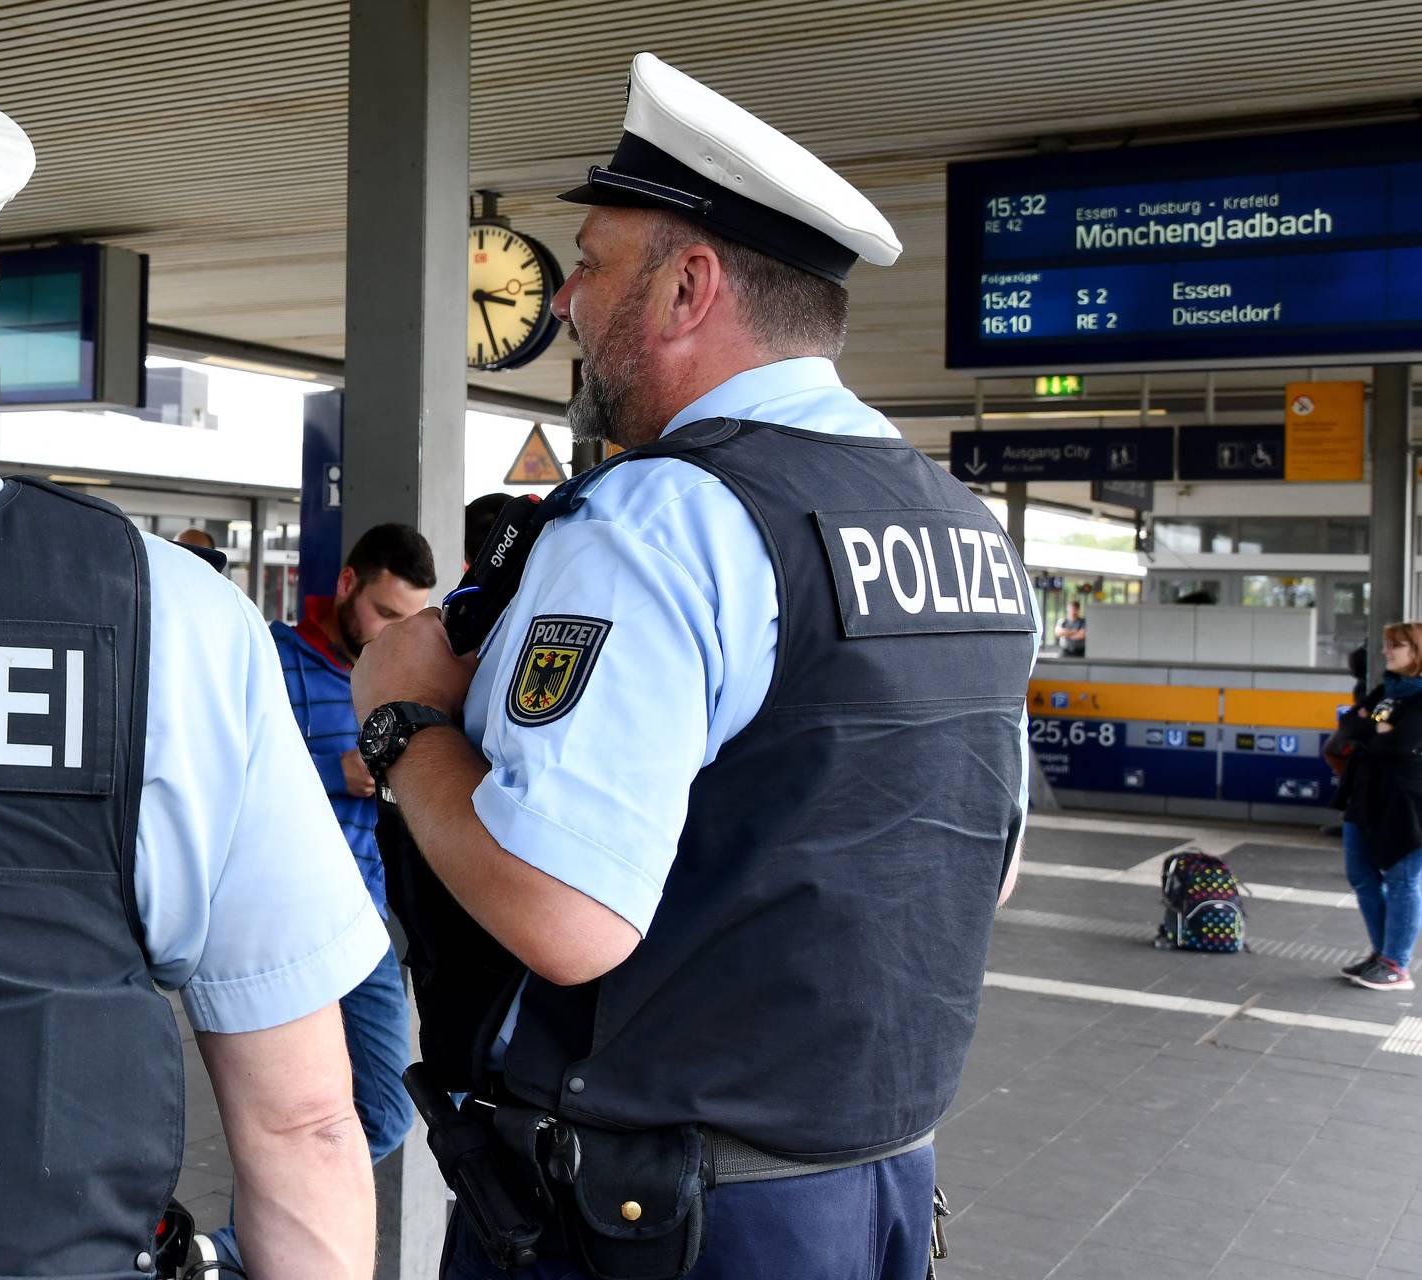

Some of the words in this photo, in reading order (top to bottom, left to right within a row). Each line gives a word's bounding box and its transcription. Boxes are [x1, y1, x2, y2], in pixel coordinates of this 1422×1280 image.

[987, 194, 1047, 217] 15:32
[1076, 207, 1118, 221] Essen
[1138, 201, 1201, 216] Duisburg
[1223, 194, 1279, 210] Krefeld
[985, 220, 1001, 233] RE
[1006, 219, 1023, 232] 42
[1076, 208, 1332, 250] Mönchengladbach
[982, 290, 1031, 310] 15:42
[1077, 289, 1089, 305] S
[1096, 288, 1108, 304] 2
[1173, 282, 1231, 300] Essen
[982, 315, 1032, 334] 16:10
[1077, 313, 1098, 330] RE
[1106, 313, 1117, 328] 2
[1173, 303, 1282, 326] Düsseldorf
[1002, 445, 1060, 461] Ausgang
[1064, 444, 1091, 460] City
[490, 524, 519, 568] DPolG
[839, 525, 1026, 615] POLIZEI
[533, 624, 598, 646] POLIZEI
[1030, 720, 1116, 747] 25,6-8
